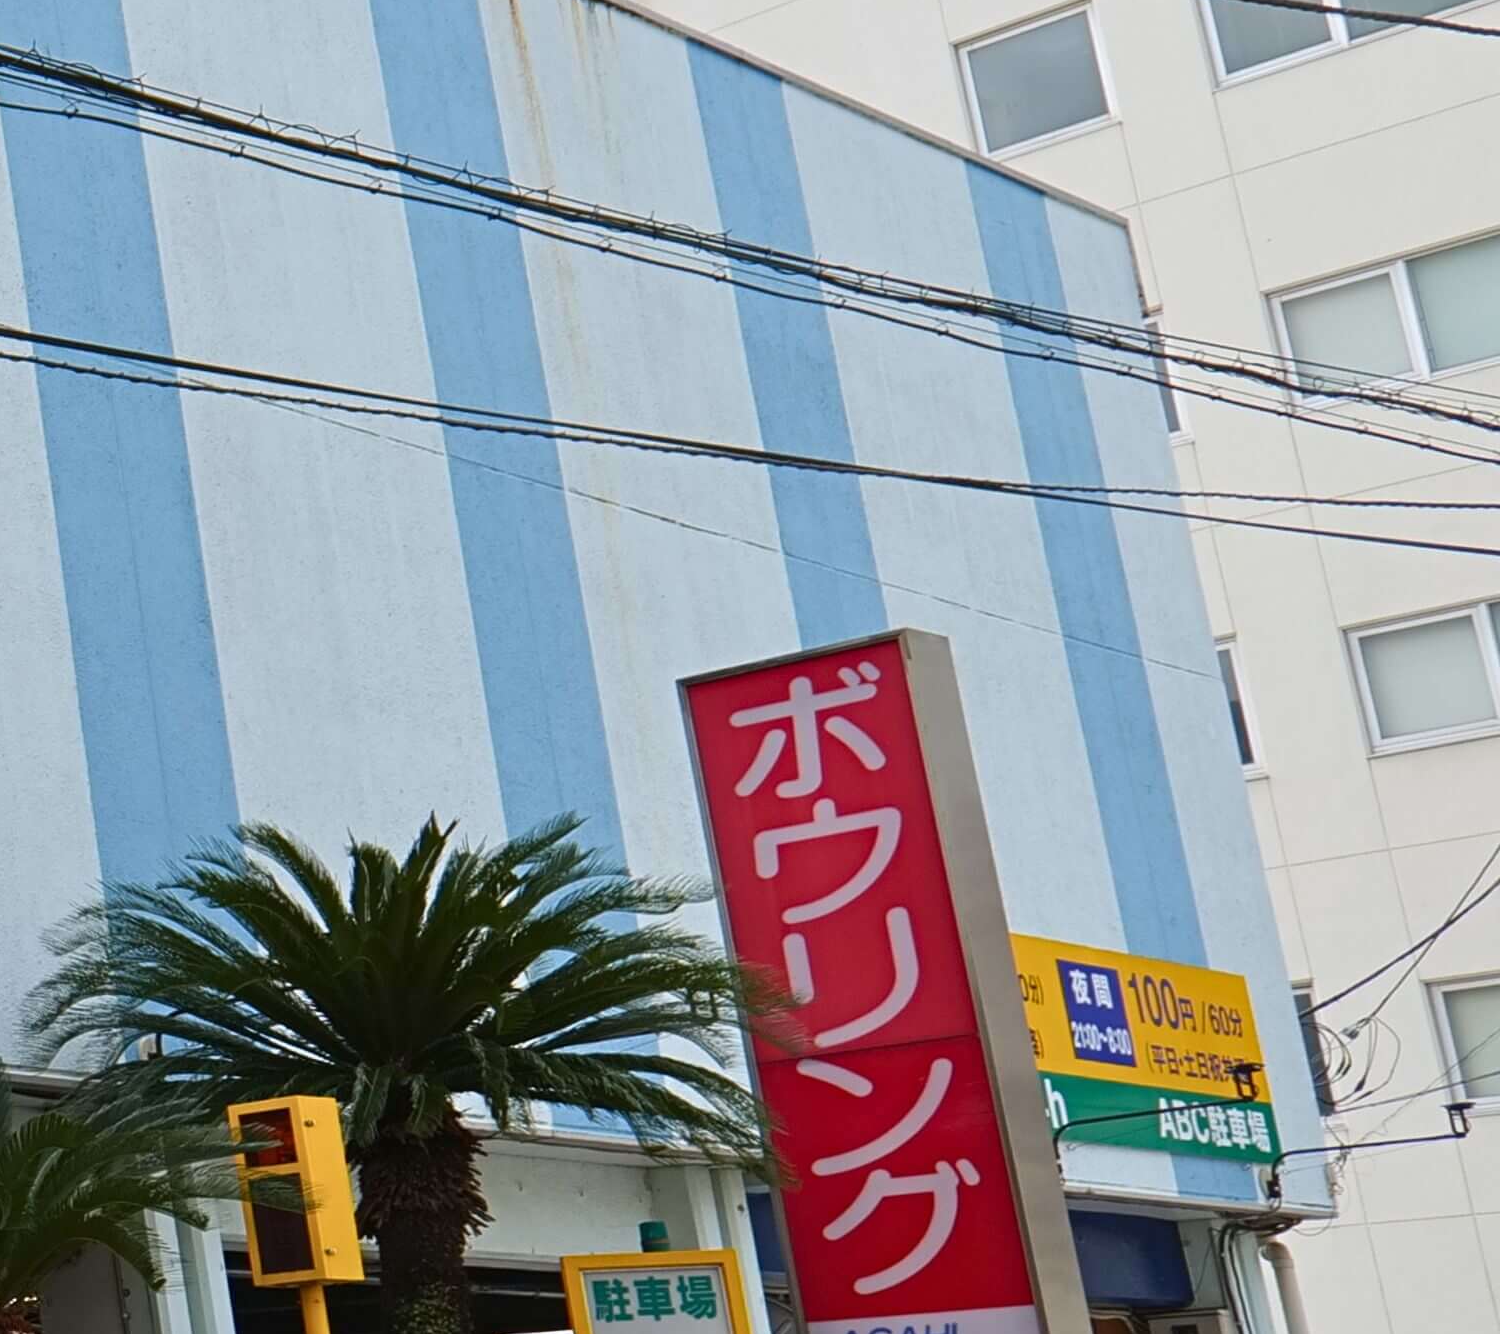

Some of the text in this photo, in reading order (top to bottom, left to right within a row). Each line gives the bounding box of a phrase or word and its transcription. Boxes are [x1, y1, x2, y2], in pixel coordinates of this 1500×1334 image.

[730, 661, 980, 1295] ボウリング
[1069, 968, 1114, 1009] 夜間
[592, 1275, 718, 1322] 駐車場
